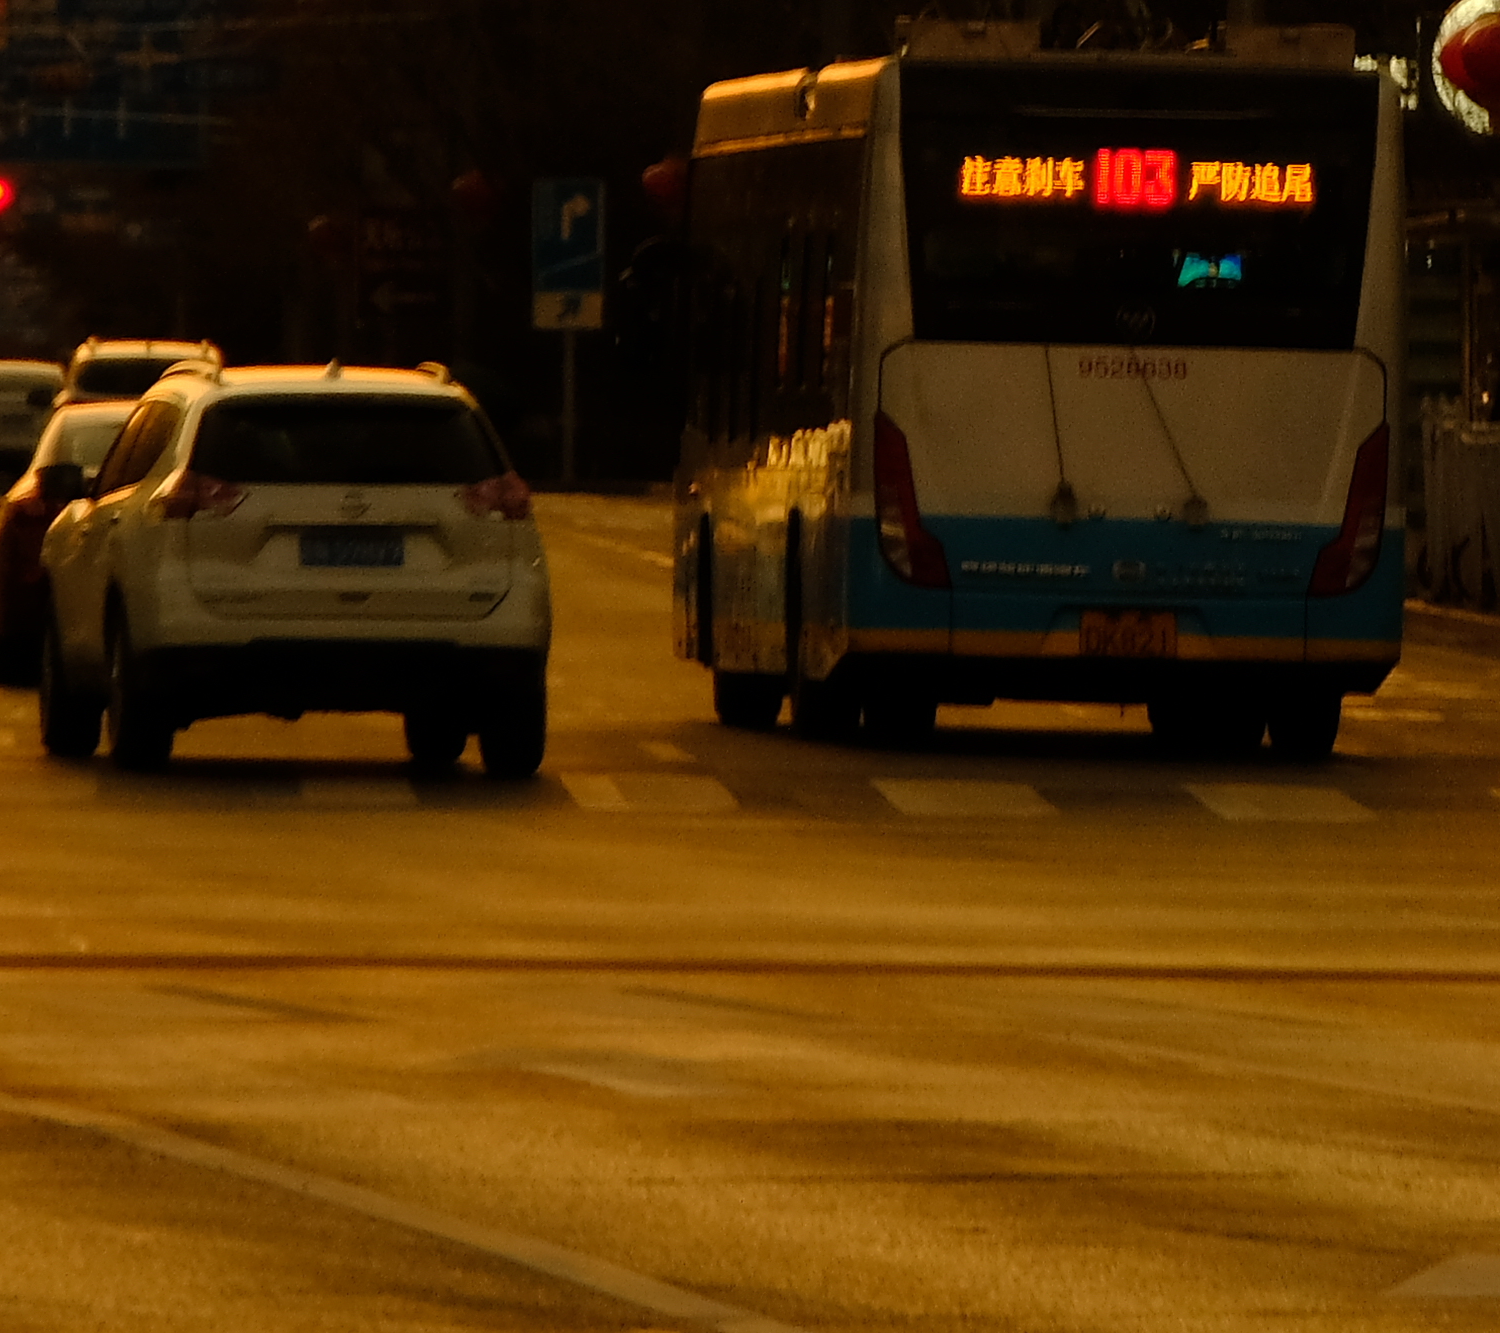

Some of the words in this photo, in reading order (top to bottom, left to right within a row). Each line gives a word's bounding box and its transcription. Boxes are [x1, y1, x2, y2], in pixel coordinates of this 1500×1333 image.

[960, 154, 1086, 198] 注意刹车
[1096, 146, 1177, 206] 103
[1187, 159, 1315, 203] 严防追尾
